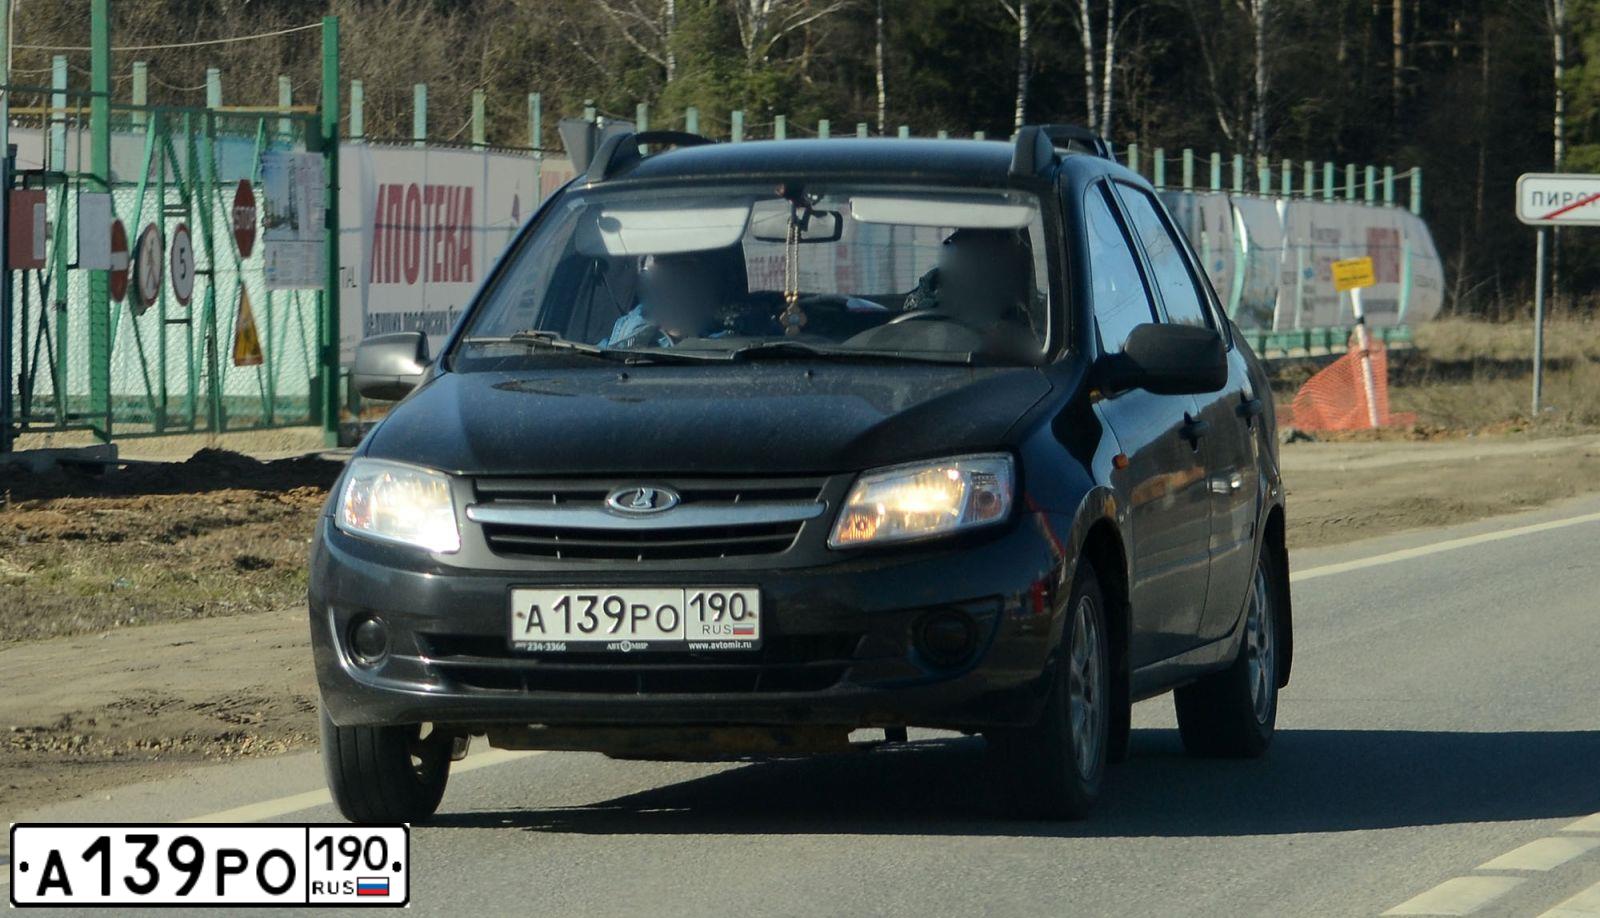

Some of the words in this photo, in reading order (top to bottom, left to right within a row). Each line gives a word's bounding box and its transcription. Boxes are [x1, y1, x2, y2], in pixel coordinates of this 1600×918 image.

[1532, 190, 1600, 207] ПИРО
[179, 246, 187, 280] 5
[688, 592, 747, 622] 190
[702, 624, 732, 635] RUS
[688, 641, 752, 650] www.avtomir.ru
